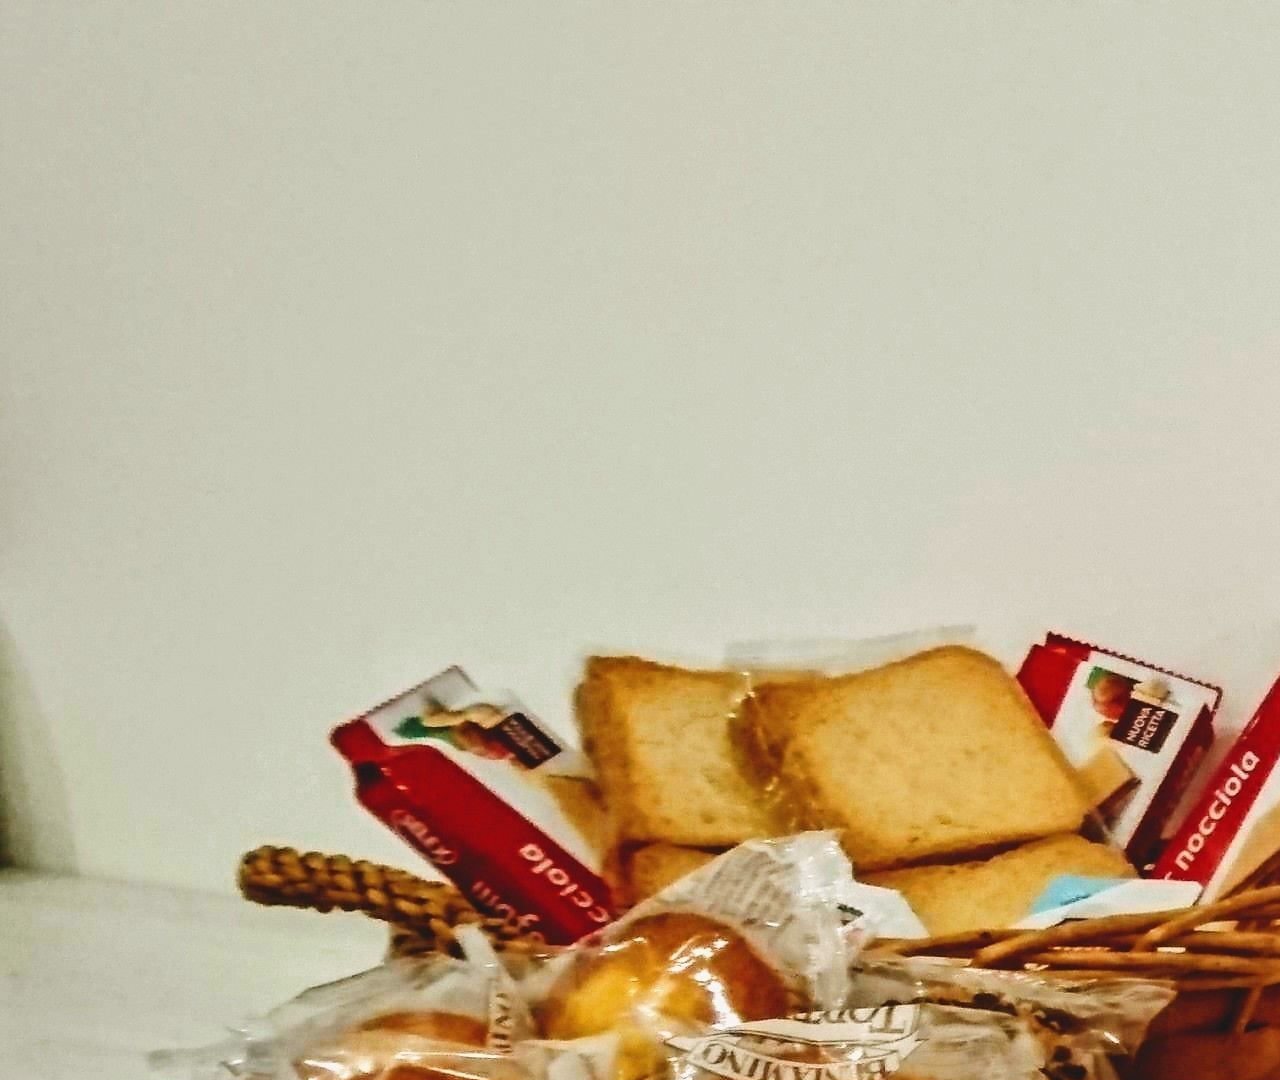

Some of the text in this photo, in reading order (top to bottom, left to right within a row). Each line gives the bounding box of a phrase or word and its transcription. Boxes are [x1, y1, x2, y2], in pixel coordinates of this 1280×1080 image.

[1126, 707, 1153, 742] NUOVA
[1138, 710, 1167, 748] RICETTA
[1175, 751, 1261, 871] nocciola
